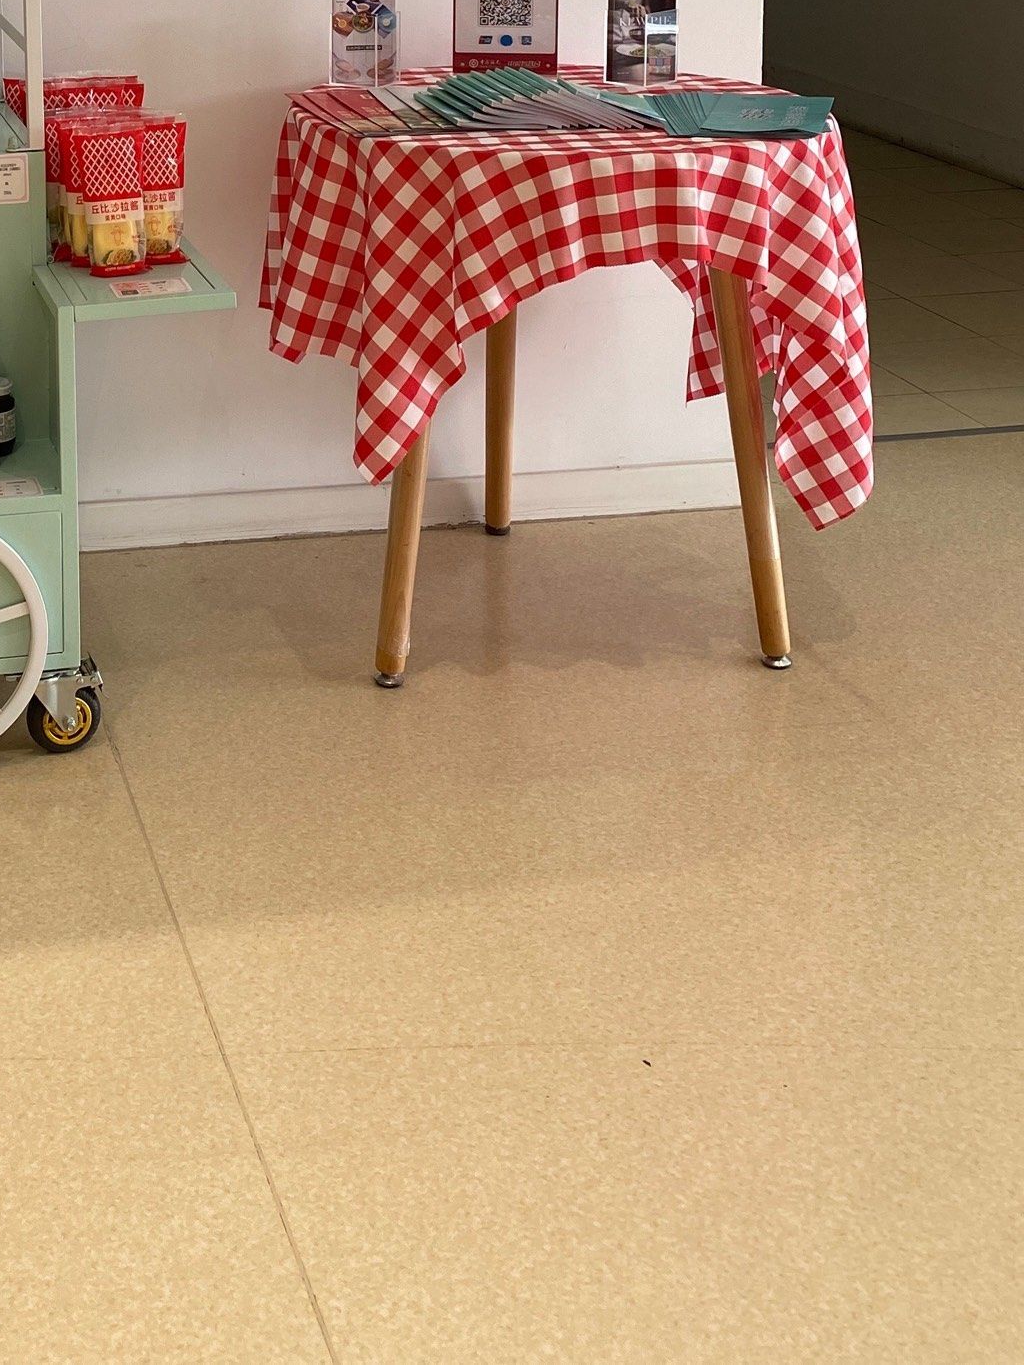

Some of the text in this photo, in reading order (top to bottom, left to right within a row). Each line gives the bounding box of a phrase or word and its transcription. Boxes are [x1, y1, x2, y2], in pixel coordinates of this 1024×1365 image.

[91, 200, 139, 214] 丘比沙拉酱
